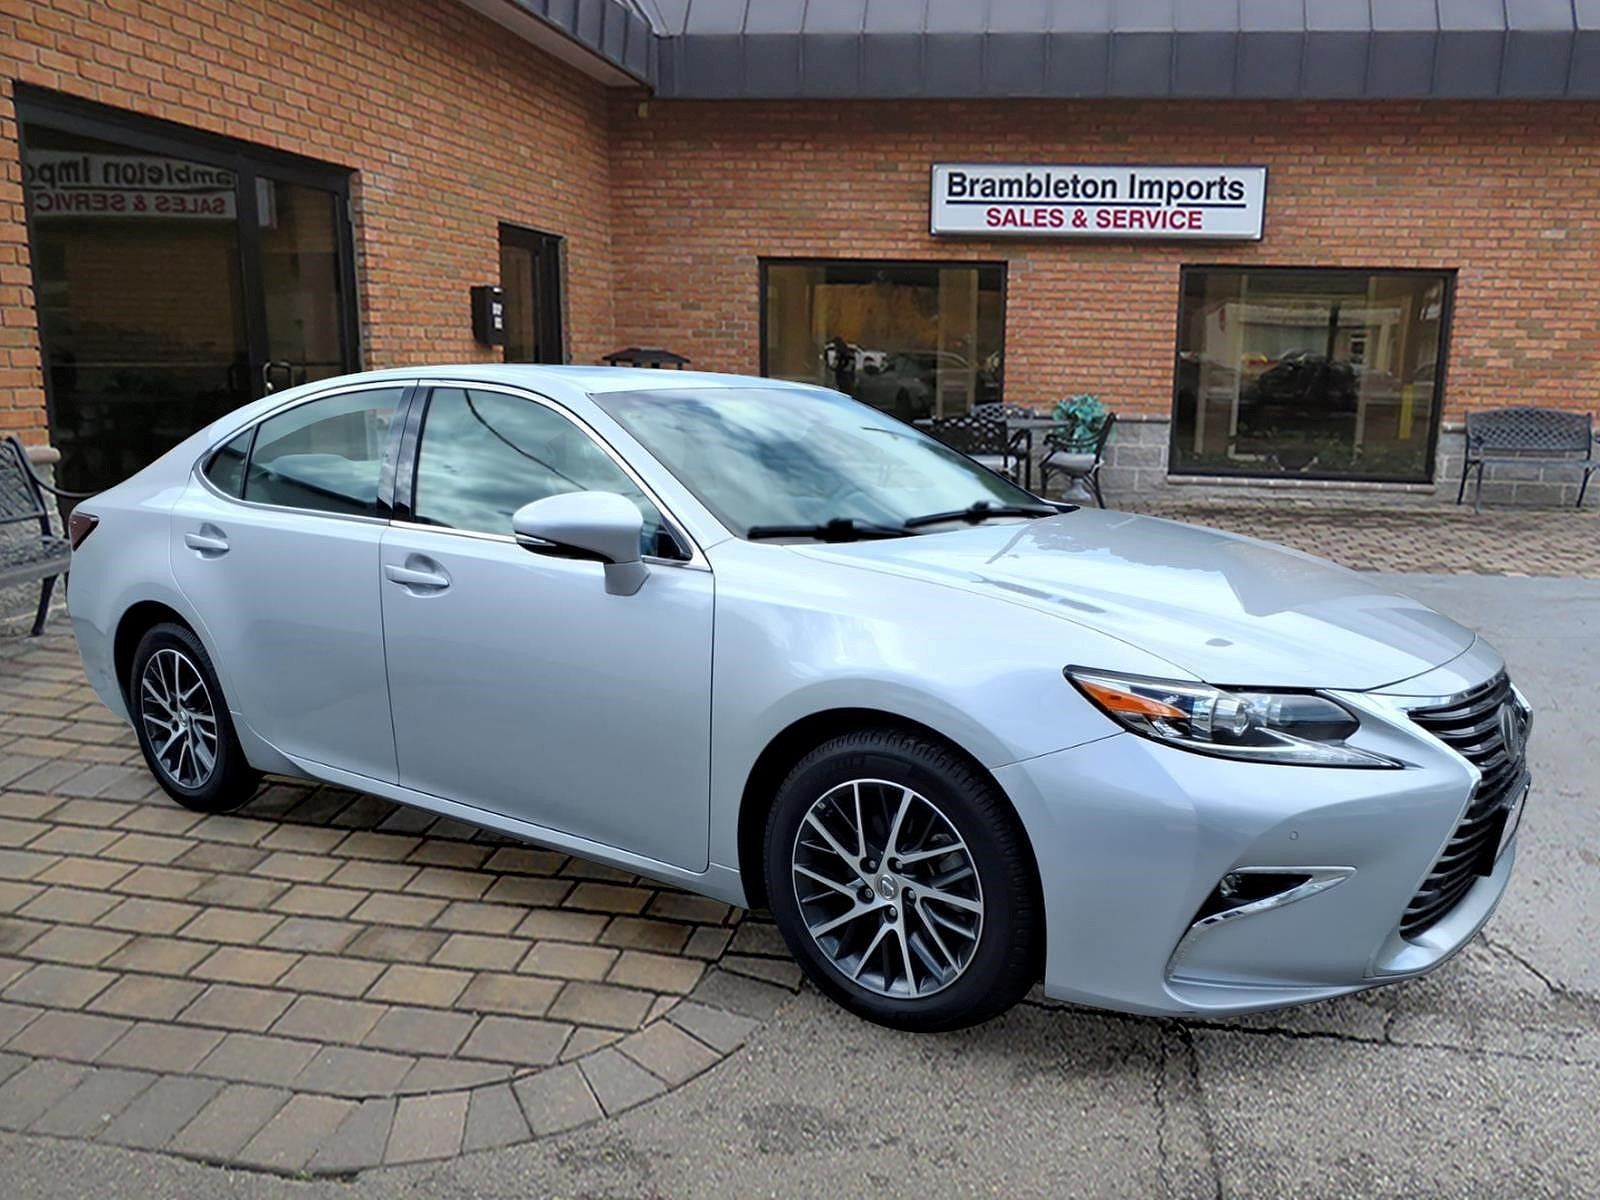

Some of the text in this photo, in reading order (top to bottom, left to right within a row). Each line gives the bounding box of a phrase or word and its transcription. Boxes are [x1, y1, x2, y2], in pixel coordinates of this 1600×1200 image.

[947, 171, 1246, 206] Brambleton Imports
[986, 208, 1204, 230] SALES & SERVICE
